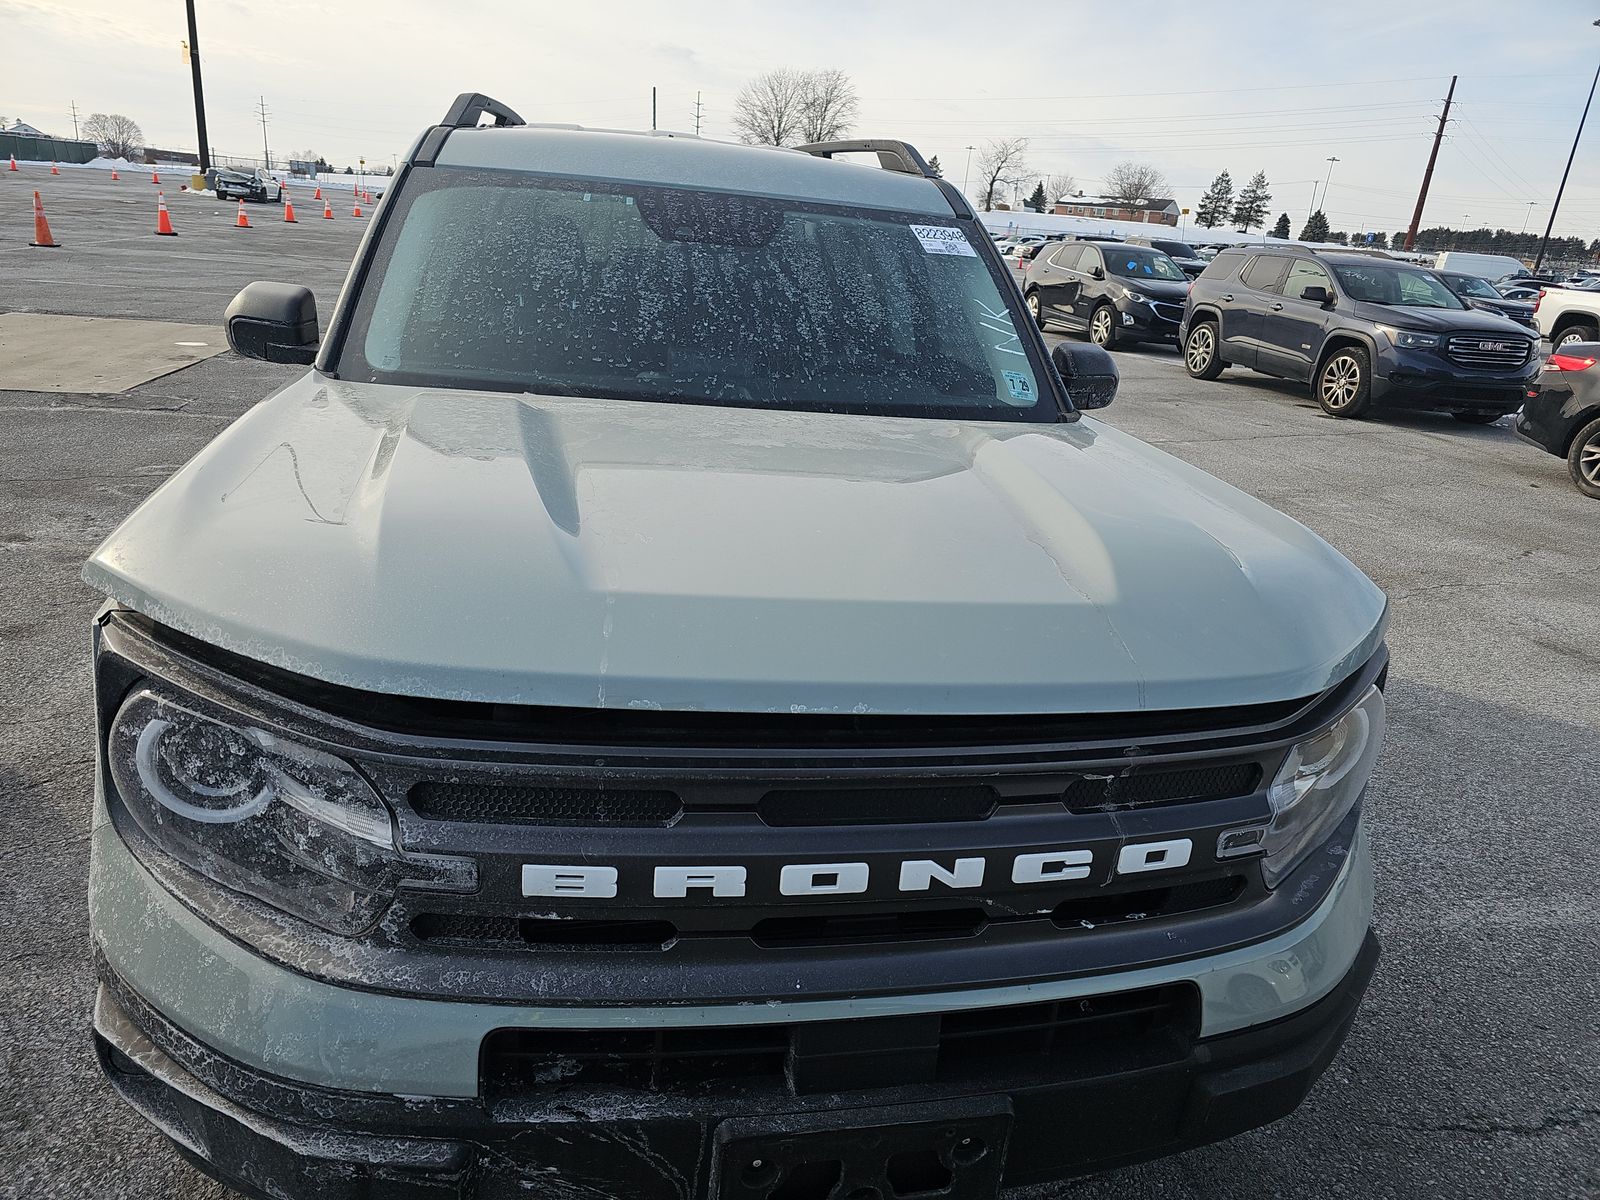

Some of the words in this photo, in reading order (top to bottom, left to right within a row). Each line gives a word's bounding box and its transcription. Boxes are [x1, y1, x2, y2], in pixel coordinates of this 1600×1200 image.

[914, 227, 967, 243] 8223948
[1479, 341, 1510, 352] GMC
[521, 837, 1194, 899] BRONCO
